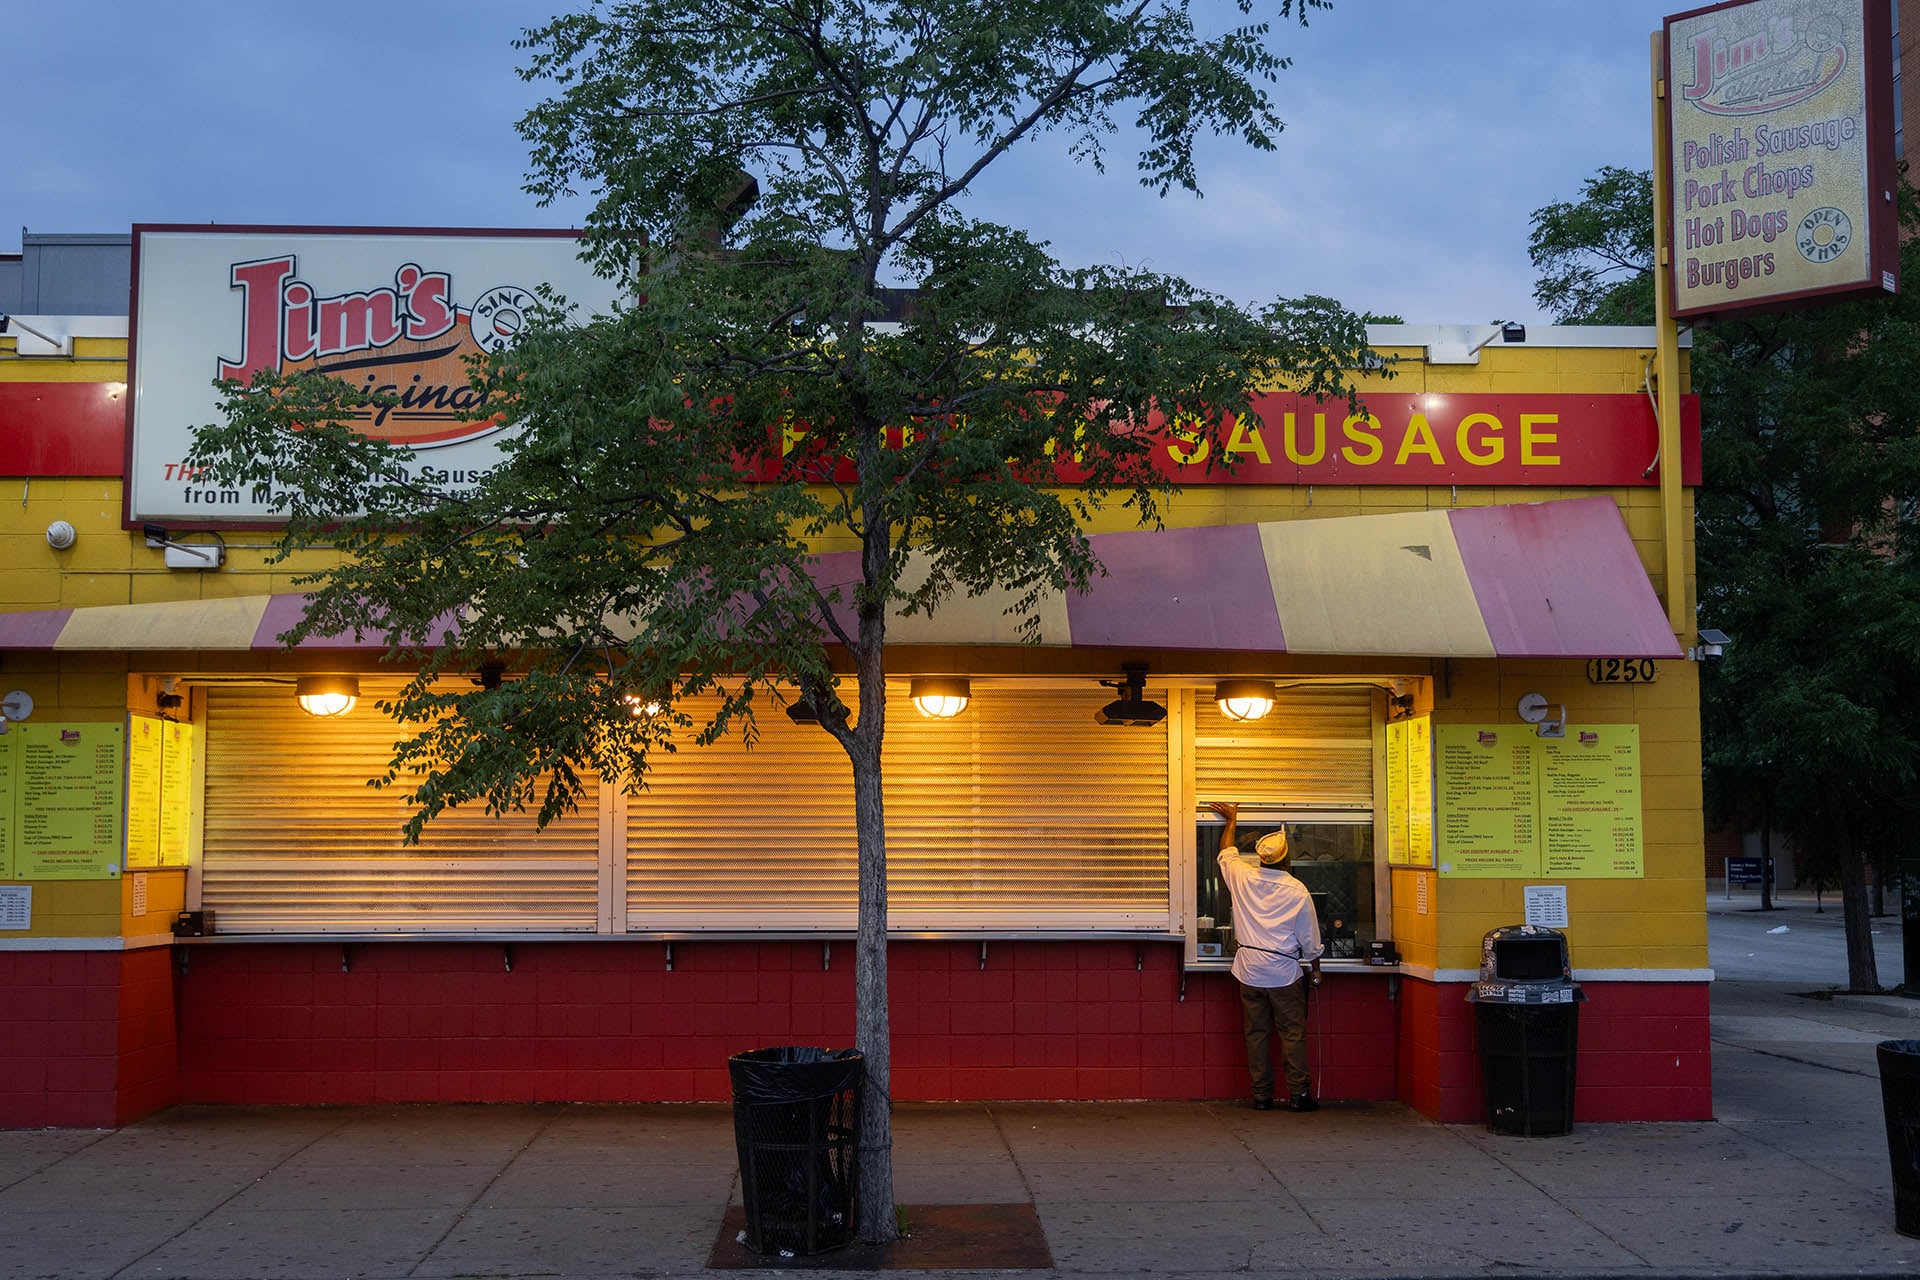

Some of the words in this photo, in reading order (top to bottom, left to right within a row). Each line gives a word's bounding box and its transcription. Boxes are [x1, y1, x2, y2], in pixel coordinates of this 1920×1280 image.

[1684, 128, 1748, 172] Polish
[1755, 117, 1855, 157] Sausage
[1685, 170, 1736, 211] Pork
[1743, 162, 1813, 199] Chops
[1686, 216, 1723, 250] Hot
[1731, 209, 1788, 243] Dogs
[1803, 210, 1842, 230] OPEN
[1800, 238, 1815, 257] 24
[1817, 235, 1848, 260] HRS
[1687, 252, 1775, 289] Burgers
[219, 256, 455, 397] Jim's
[1167, 412, 1561, 466] SAUSAGE
[421, 466, 494, 483] Sausa
[184, 487, 240, 504] from
[1596, 658, 1655, 681] 1250
